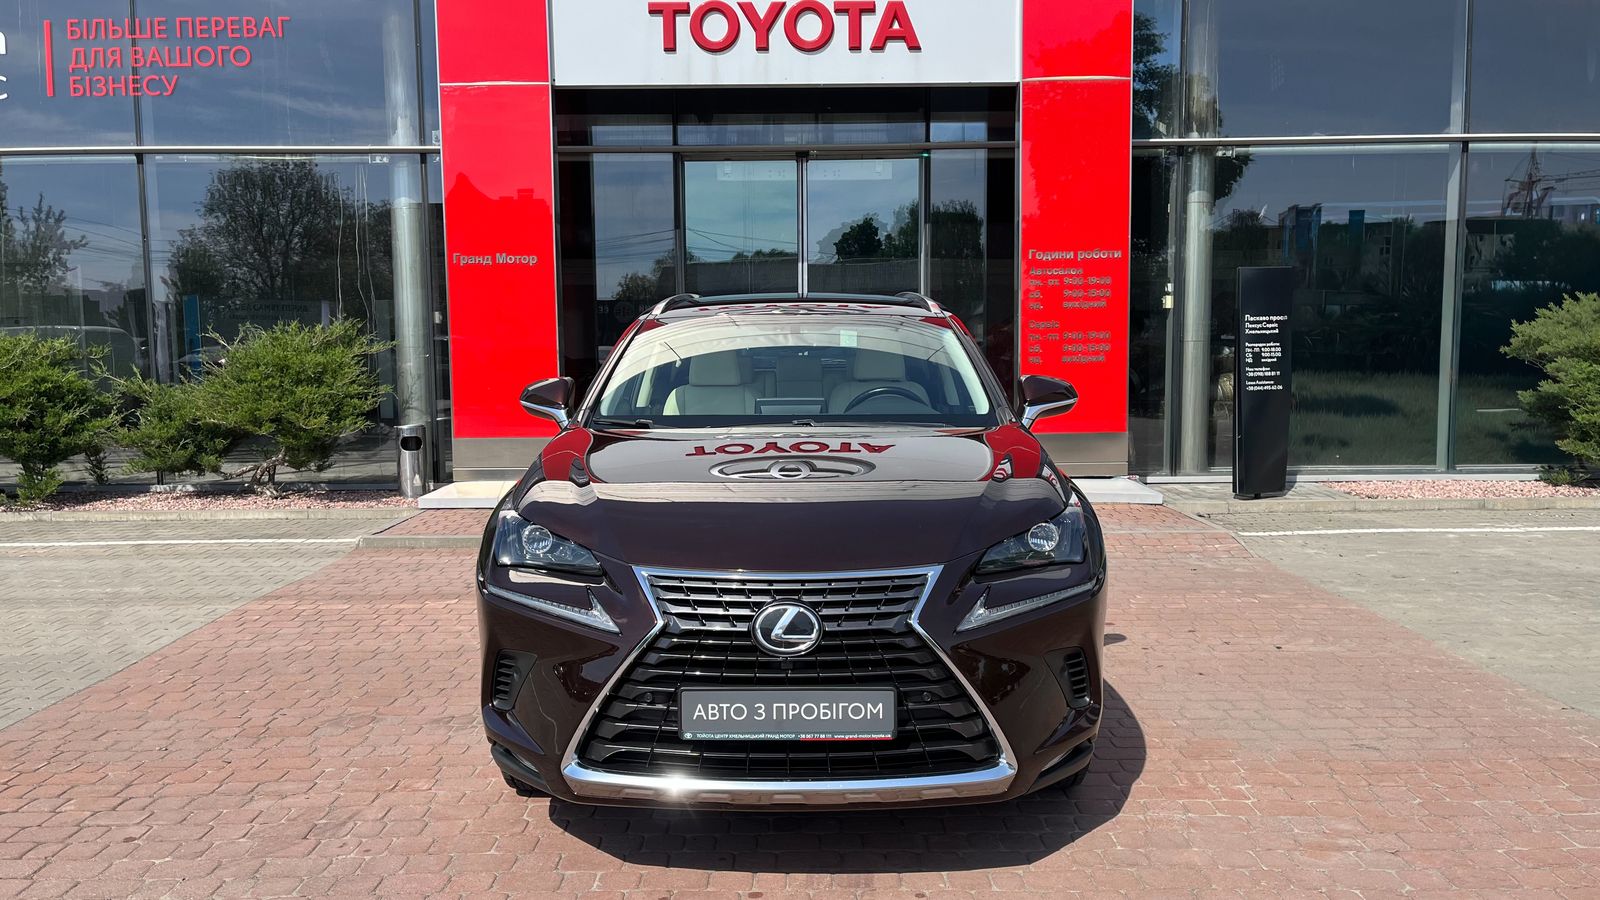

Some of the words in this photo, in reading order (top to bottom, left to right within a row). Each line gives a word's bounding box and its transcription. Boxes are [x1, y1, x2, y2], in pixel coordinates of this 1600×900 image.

[66, 17, 167, 40] БІЛЬШЕ
[175, 16, 291, 39] ПЕРЕВАГ
[648, 0, 922, 52] TOYOTA
[69, 47, 122, 73] ДЛЯ
[131, 45, 252, 68] ВАШОГО
[69, 75, 179, 97] БІЗНЕСУ
[452, 252, 492, 265] Гранд
[495, 252, 538, 266] Мотор
[1028, 249, 1074, 260] Години
[1077, 248, 1122, 261] роботи
[1030, 267, 1083, 275] Автосалон
[693, 703, 748, 720] АВТО
[753, 703, 766, 720] З
[773, 702, 884, 720] ПРОБІГОМ
